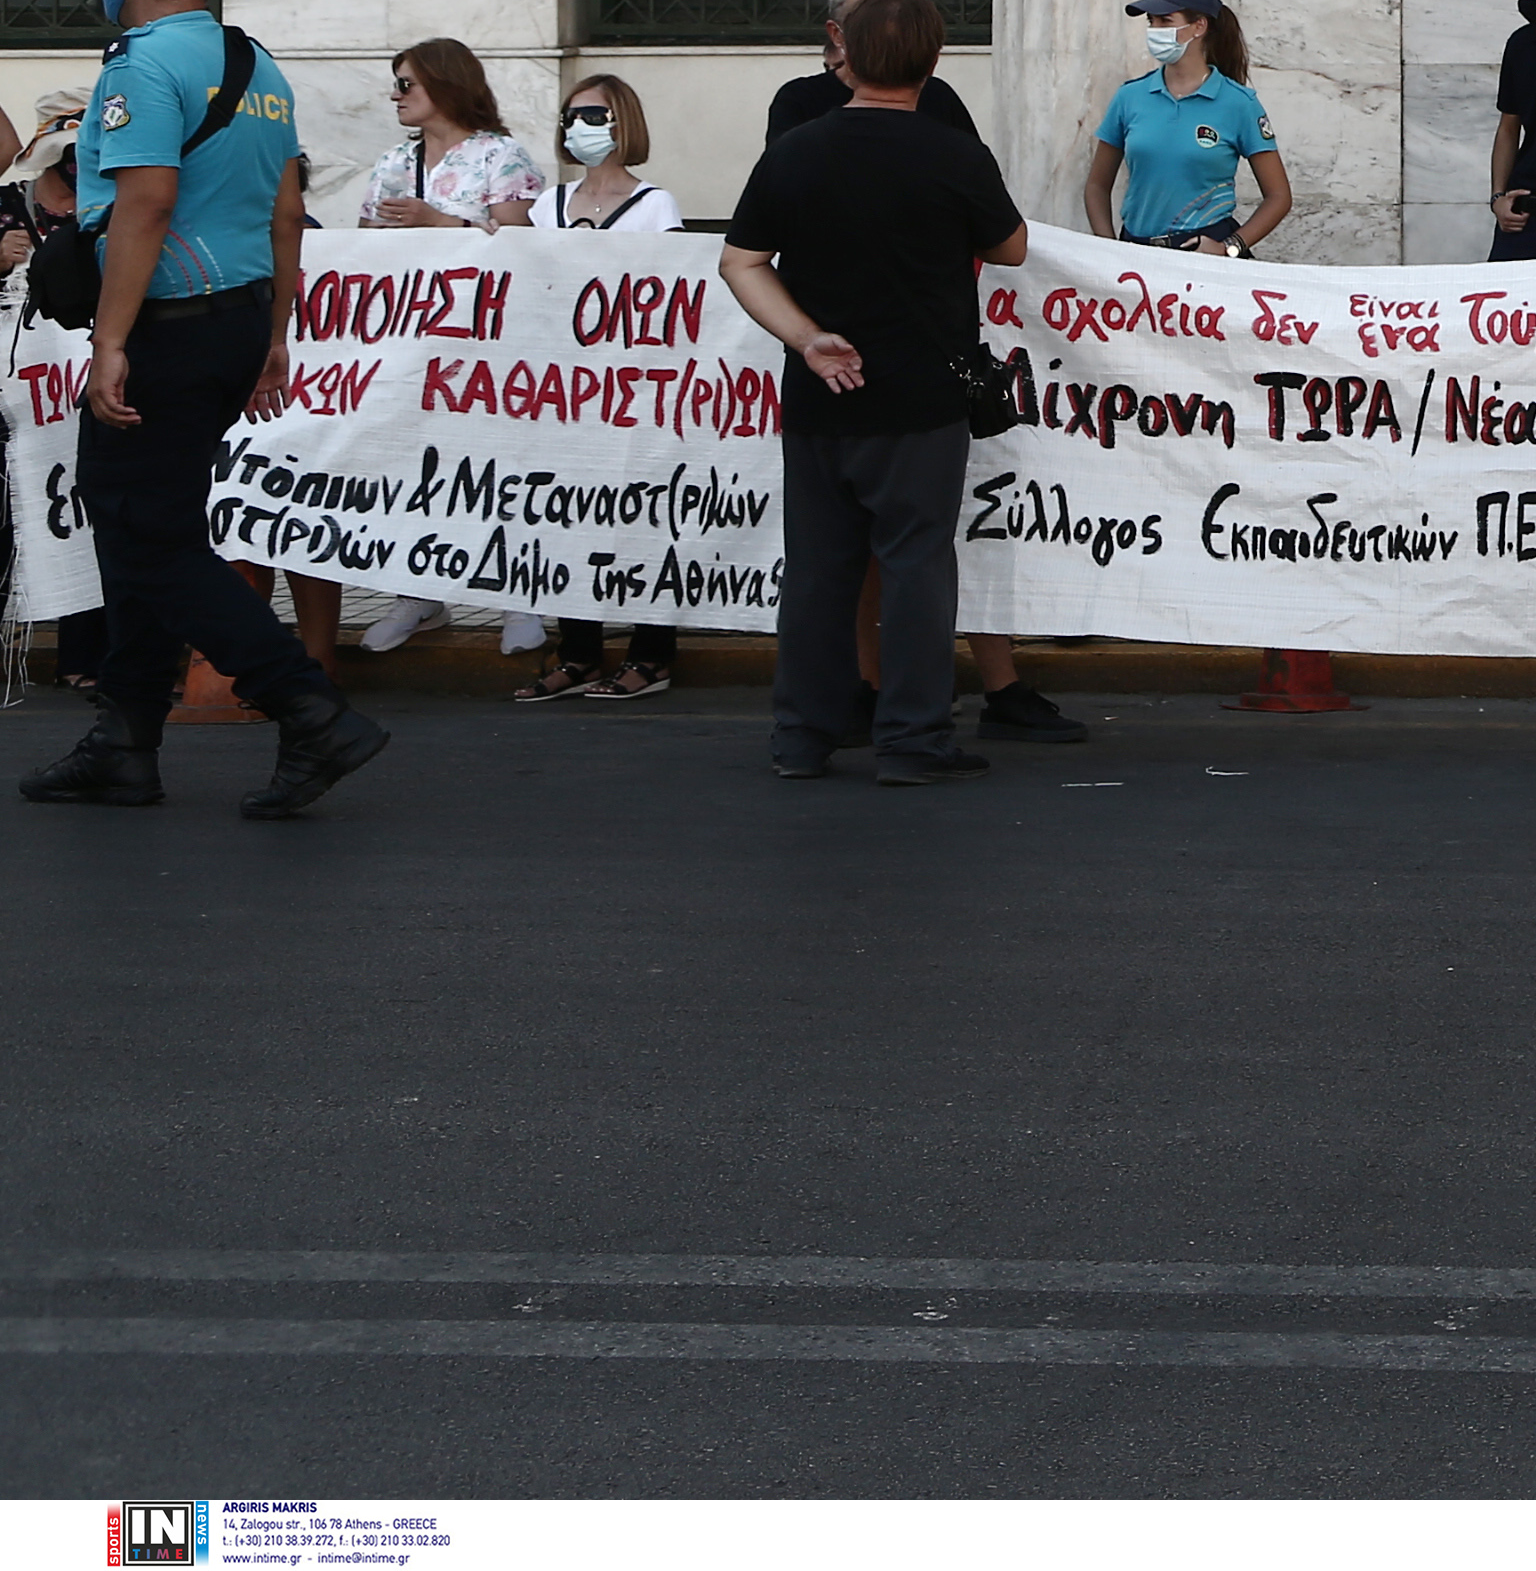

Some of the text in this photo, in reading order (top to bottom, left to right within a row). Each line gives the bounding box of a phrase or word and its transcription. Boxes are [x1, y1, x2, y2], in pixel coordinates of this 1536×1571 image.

[206, 85, 290, 125] PLICE
[573, 273, 706, 349] ΟΛΩΝ
[1042, 271, 1226, 342] σχολεία
[1251, 289, 1320, 345] δεν
[405, 444, 446, 517] &
[966, 471, 1163, 567] Σύλλογος
[1201, 483, 1459, 563] Εκπαιδευτικών
[467, 524, 571, 608] Δήμο
